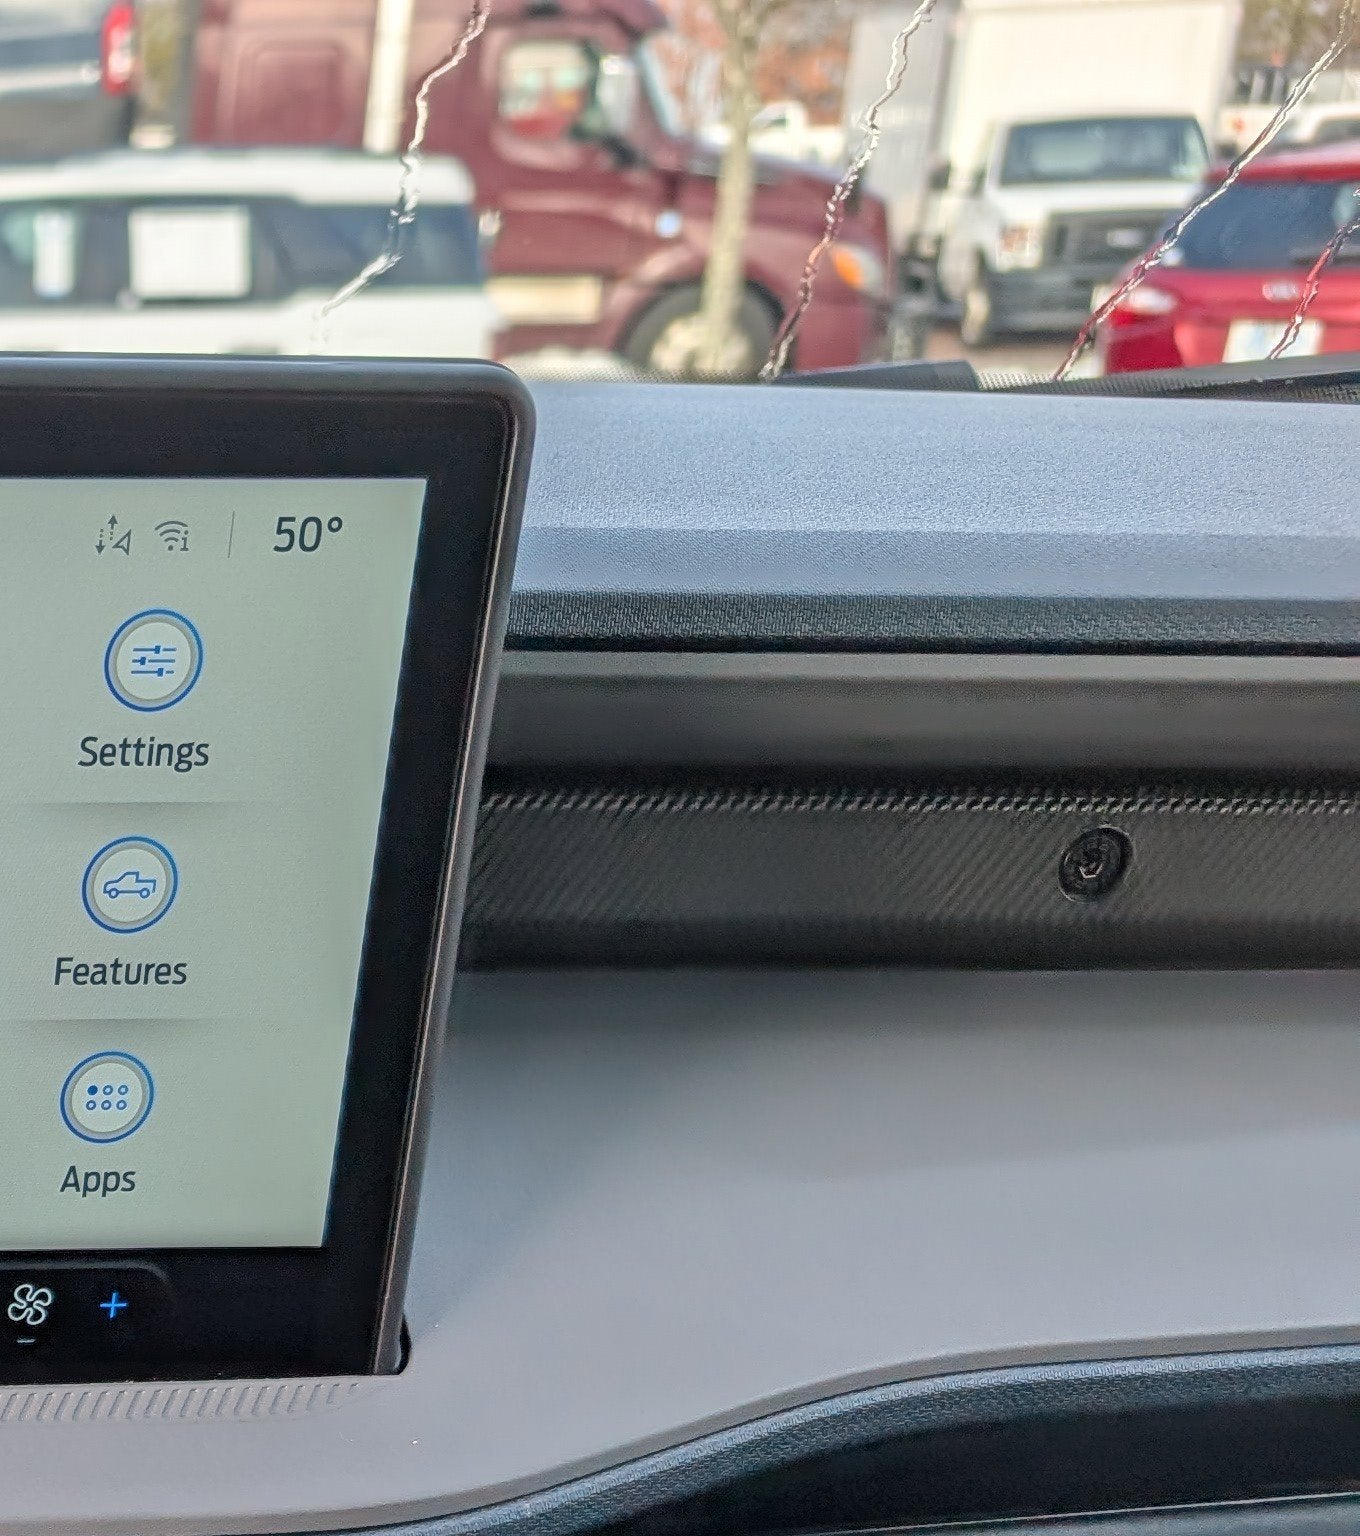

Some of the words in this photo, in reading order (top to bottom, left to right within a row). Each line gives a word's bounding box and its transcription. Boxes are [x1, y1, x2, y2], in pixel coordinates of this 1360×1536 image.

[272, 516, 344, 554] 50°
[78, 736, 210, 772] Settings
[53, 956, 189, 987] Features
[60, 1165, 137, 1198] Apps
